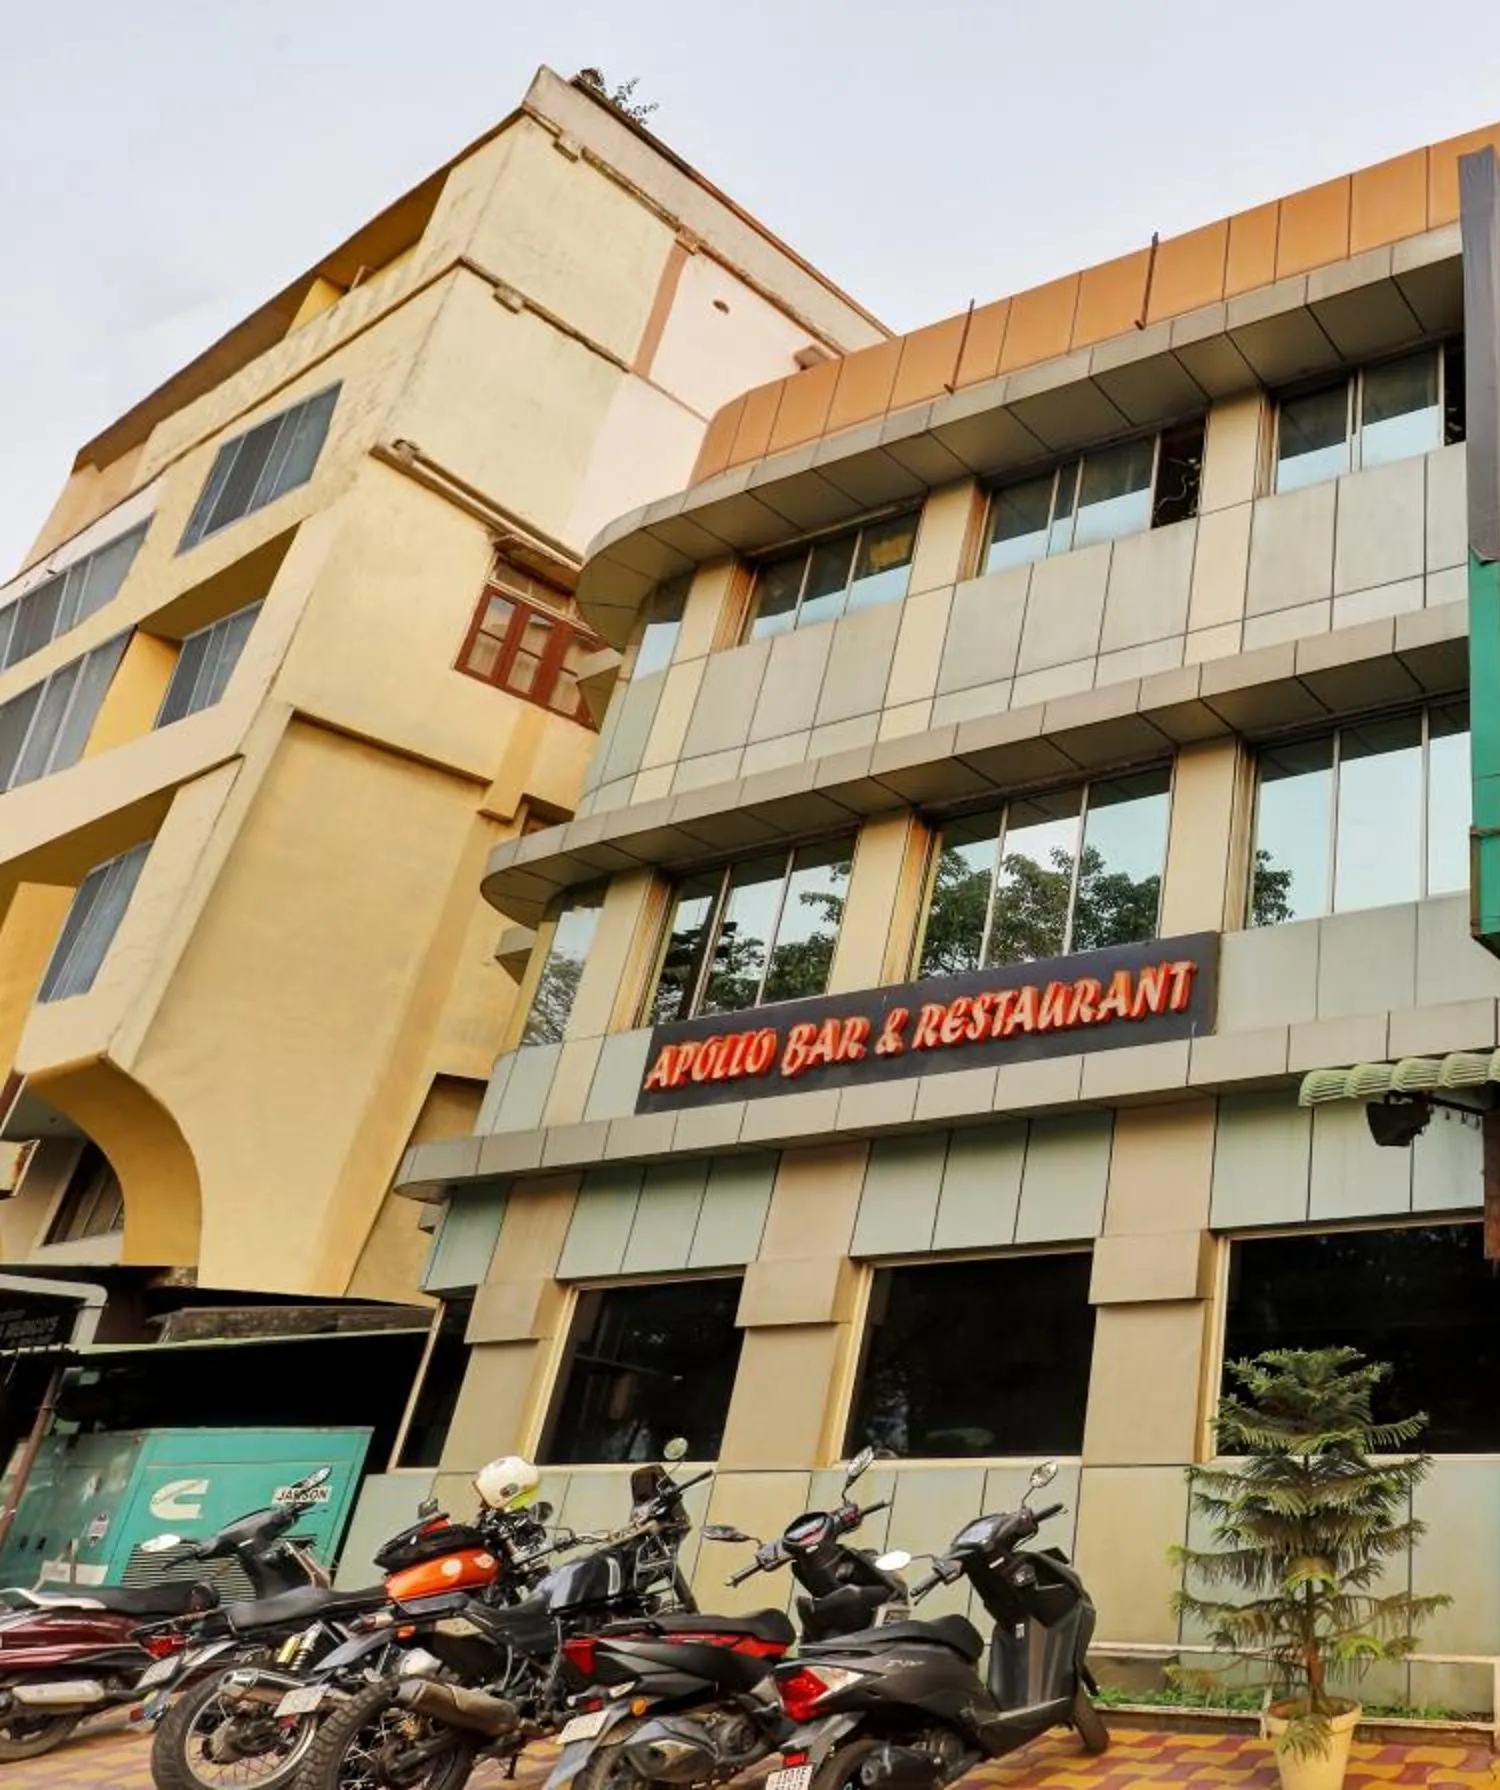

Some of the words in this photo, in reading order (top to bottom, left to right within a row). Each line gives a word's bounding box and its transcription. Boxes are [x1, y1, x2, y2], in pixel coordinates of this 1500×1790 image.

[643, 1027, 778, 1092] APOLLO
[780, 1015, 871, 1079] BAR
[874, 1007, 909, 1057] &
[911, 959, 1197, 1049] RESTAURANT
